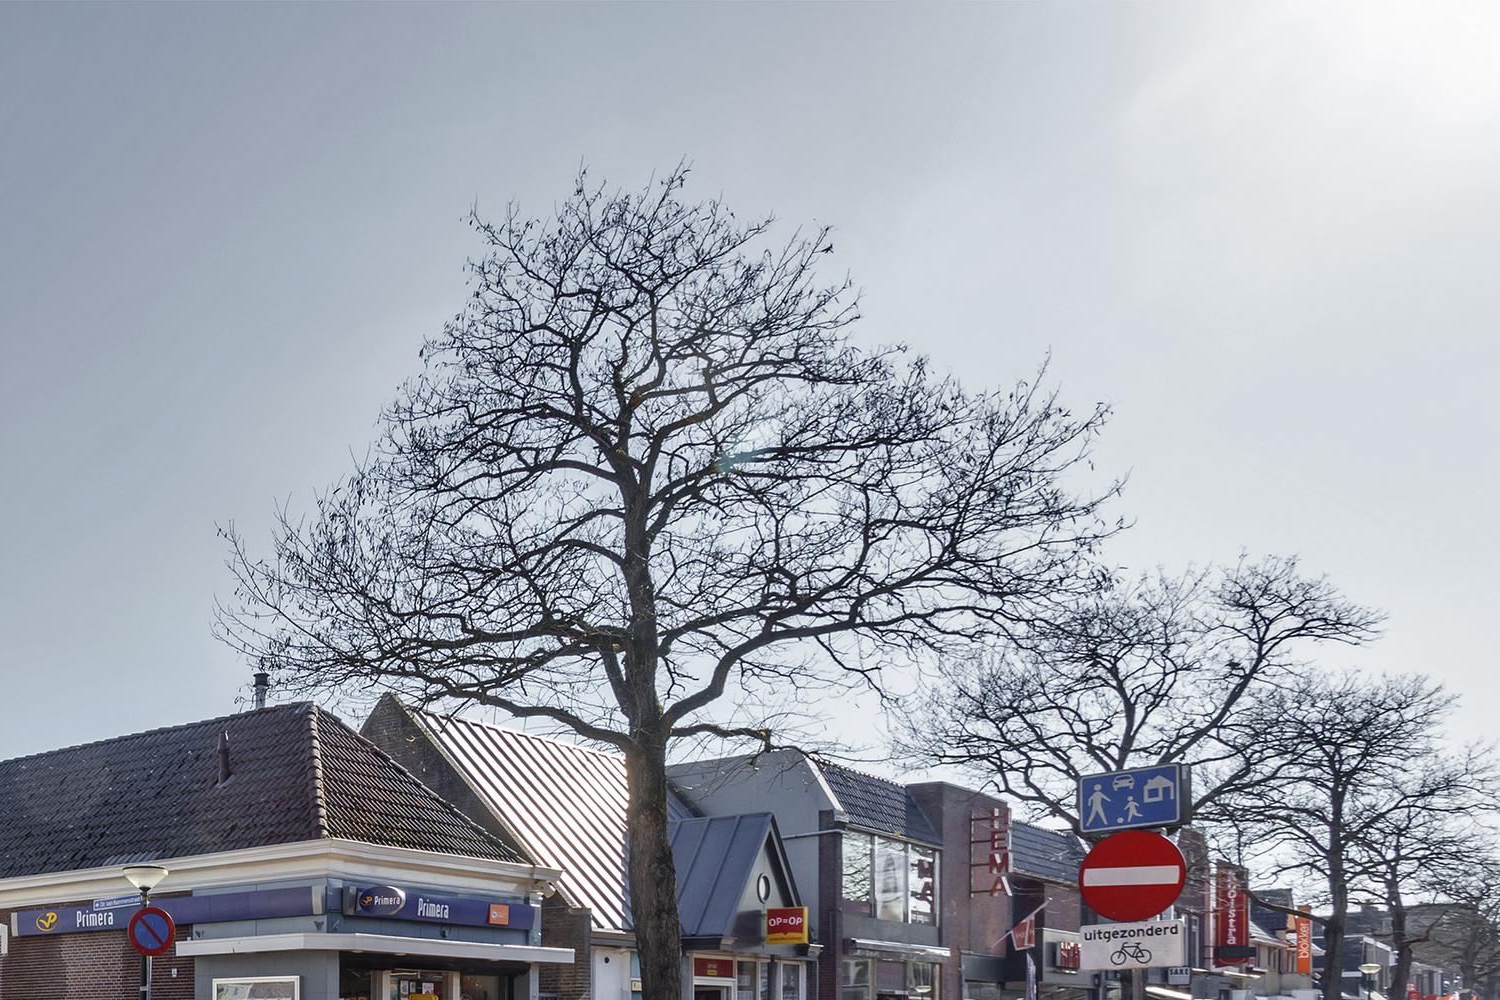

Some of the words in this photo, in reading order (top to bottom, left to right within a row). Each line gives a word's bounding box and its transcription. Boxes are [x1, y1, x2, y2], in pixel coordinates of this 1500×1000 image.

[989, 808, 1012, 896] HEMA
[374, 895, 400, 905] Primera
[417, 898, 449, 918] Primera
[76, 910, 114, 927] Primera
[768, 917, 803, 927] OP=OP
[1084, 924, 1179, 942] uitgezonderd
[1298, 923, 1310, 959] blokker
